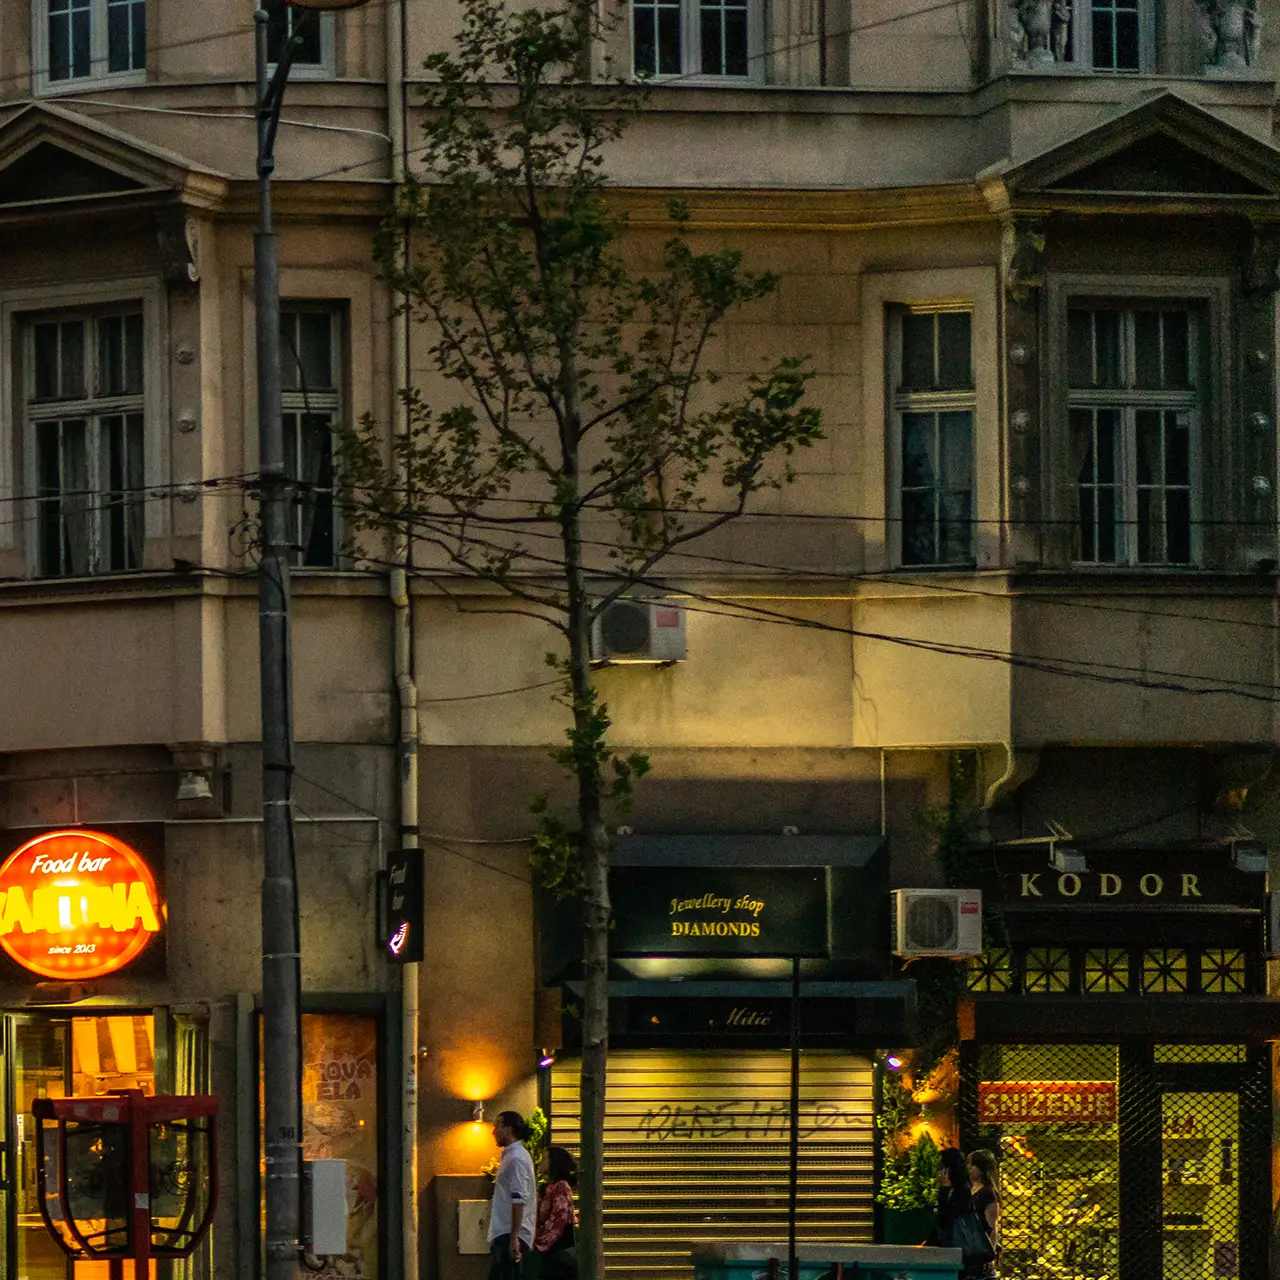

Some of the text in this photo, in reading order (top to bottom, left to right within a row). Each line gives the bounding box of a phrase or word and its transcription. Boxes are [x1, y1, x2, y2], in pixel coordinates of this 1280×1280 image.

[30, 851, 111, 874] Food bar
[1020, 873, 1203, 897] KODOR
[669, 892, 766, 917] Jewellery shop
[671, 921, 761, 937] DIAMONDS
[48, 944, 96, 954] since 2013
